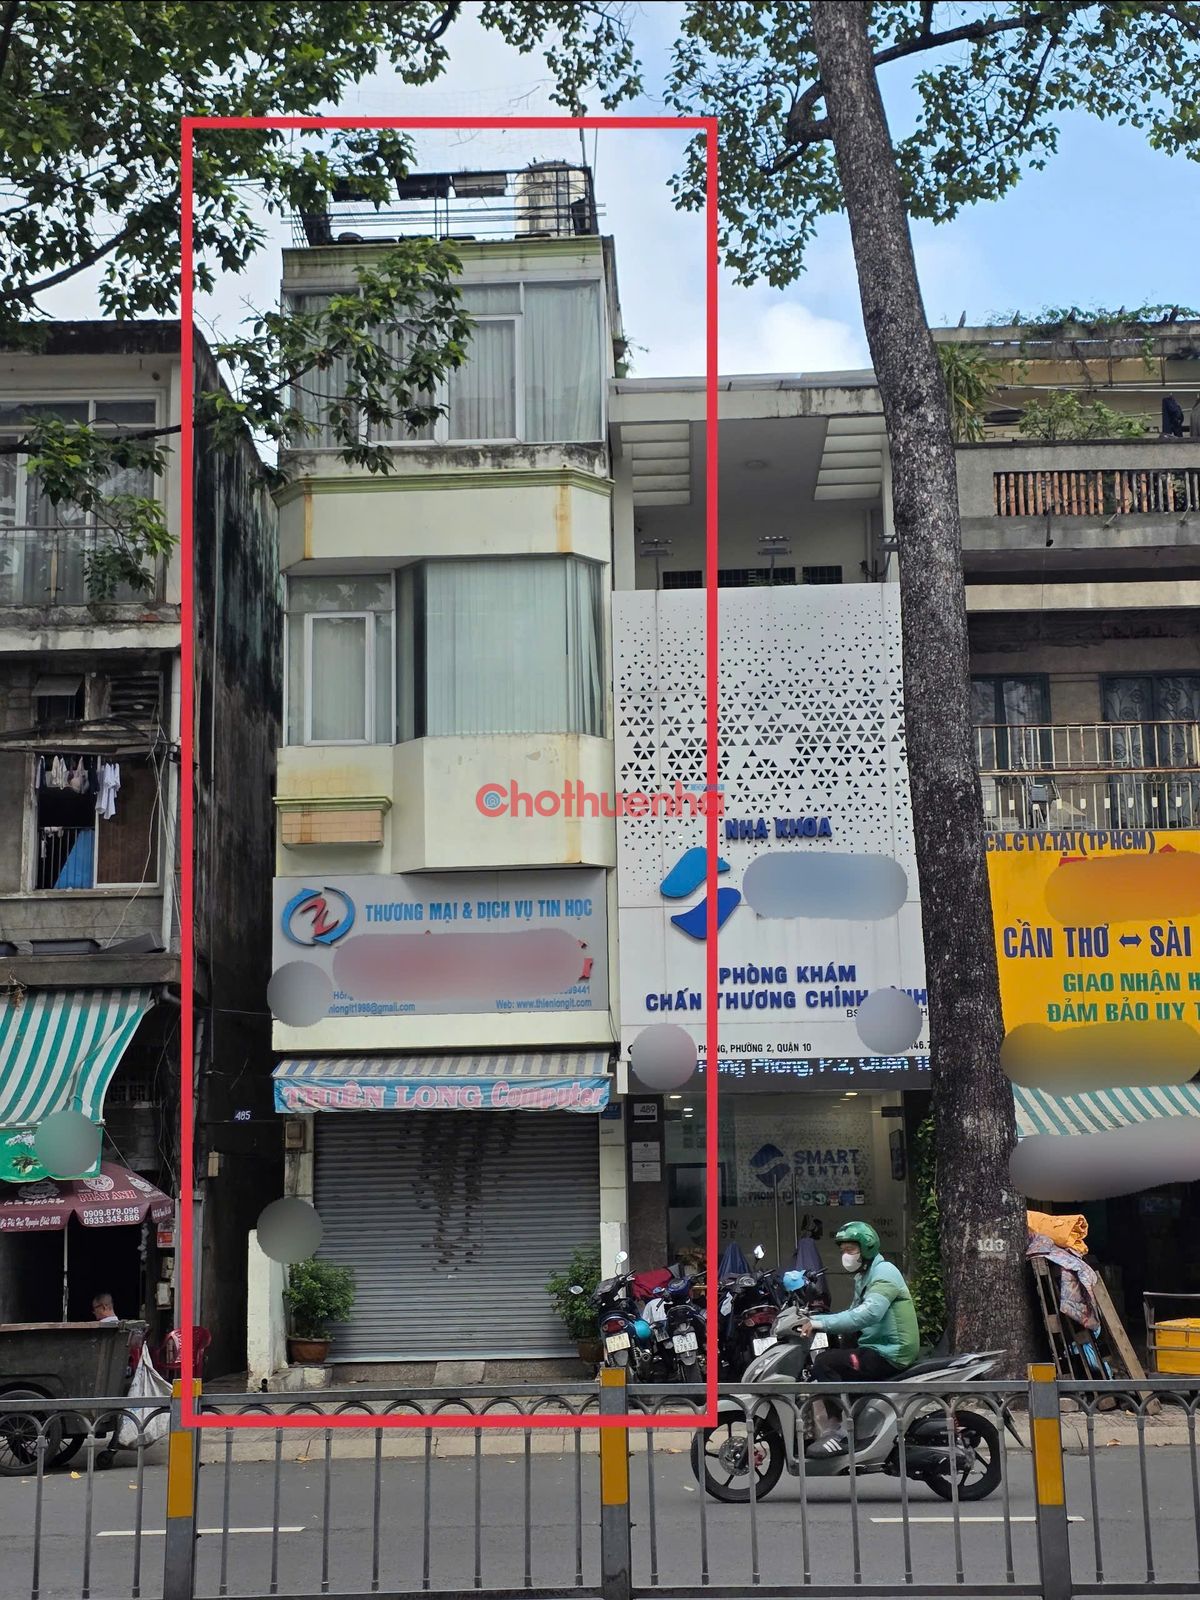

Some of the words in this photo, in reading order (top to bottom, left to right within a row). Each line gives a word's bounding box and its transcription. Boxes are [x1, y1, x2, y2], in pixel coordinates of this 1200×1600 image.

[725, 817, 768, 840] NHA
[775, 817, 832, 839] KHOA
[366, 902, 423, 922] THƯƠNG
[429, 902, 457, 924] MẠI
[462, 902, 473, 919] &
[477, 900, 509, 922] DỊCH
[515, 900, 533, 922] VỤ
[538, 899, 560, 917] TIN
[565, 898, 593, 921] HỌC
[1003, 918, 1053, 958] CẦN
[1063, 923, 1109, 957] THƠ
[1150, 920, 1192, 957] SÀI
[719, 962, 787, 984] PHÒNG
[796, 962, 857, 983] KHÁM
[1063, 972, 1114, 992] GIAO
[1120, 969, 1181, 995] NHẬN
[496, 999, 515, 1009] Web:
[516, 998, 592, 1009] www.thienlongit.com
[645, 987, 702, 1011] CHẤN
[1047, 997, 1097, 1022] ĐẢM
[1105, 996, 1148, 1021] BẢO
[1156, 1002, 1185, 1021] UY
[730, 1041, 763, 1053] PHƯỜNG
[766, 1043, 774, 1054] 2,
[777, 1041, 799, 1054] QUẬN
[802, 1043, 811, 1052] 10
[283, 1080, 385, 1109] THIÊN
[396, 1085, 484, 1109] LONG
[491, 1080, 606, 1108] Computer
[234, 1110, 252, 1121] 485
[640, 1104, 656, 1114] 489
[793, 1148, 860, 1165] SMART
[794, 1165, 862, 1177] DENTAL
[83, 1206, 139, 1218] 0909.879.096
[83, 1214, 140, 1225] 0933.345.886
